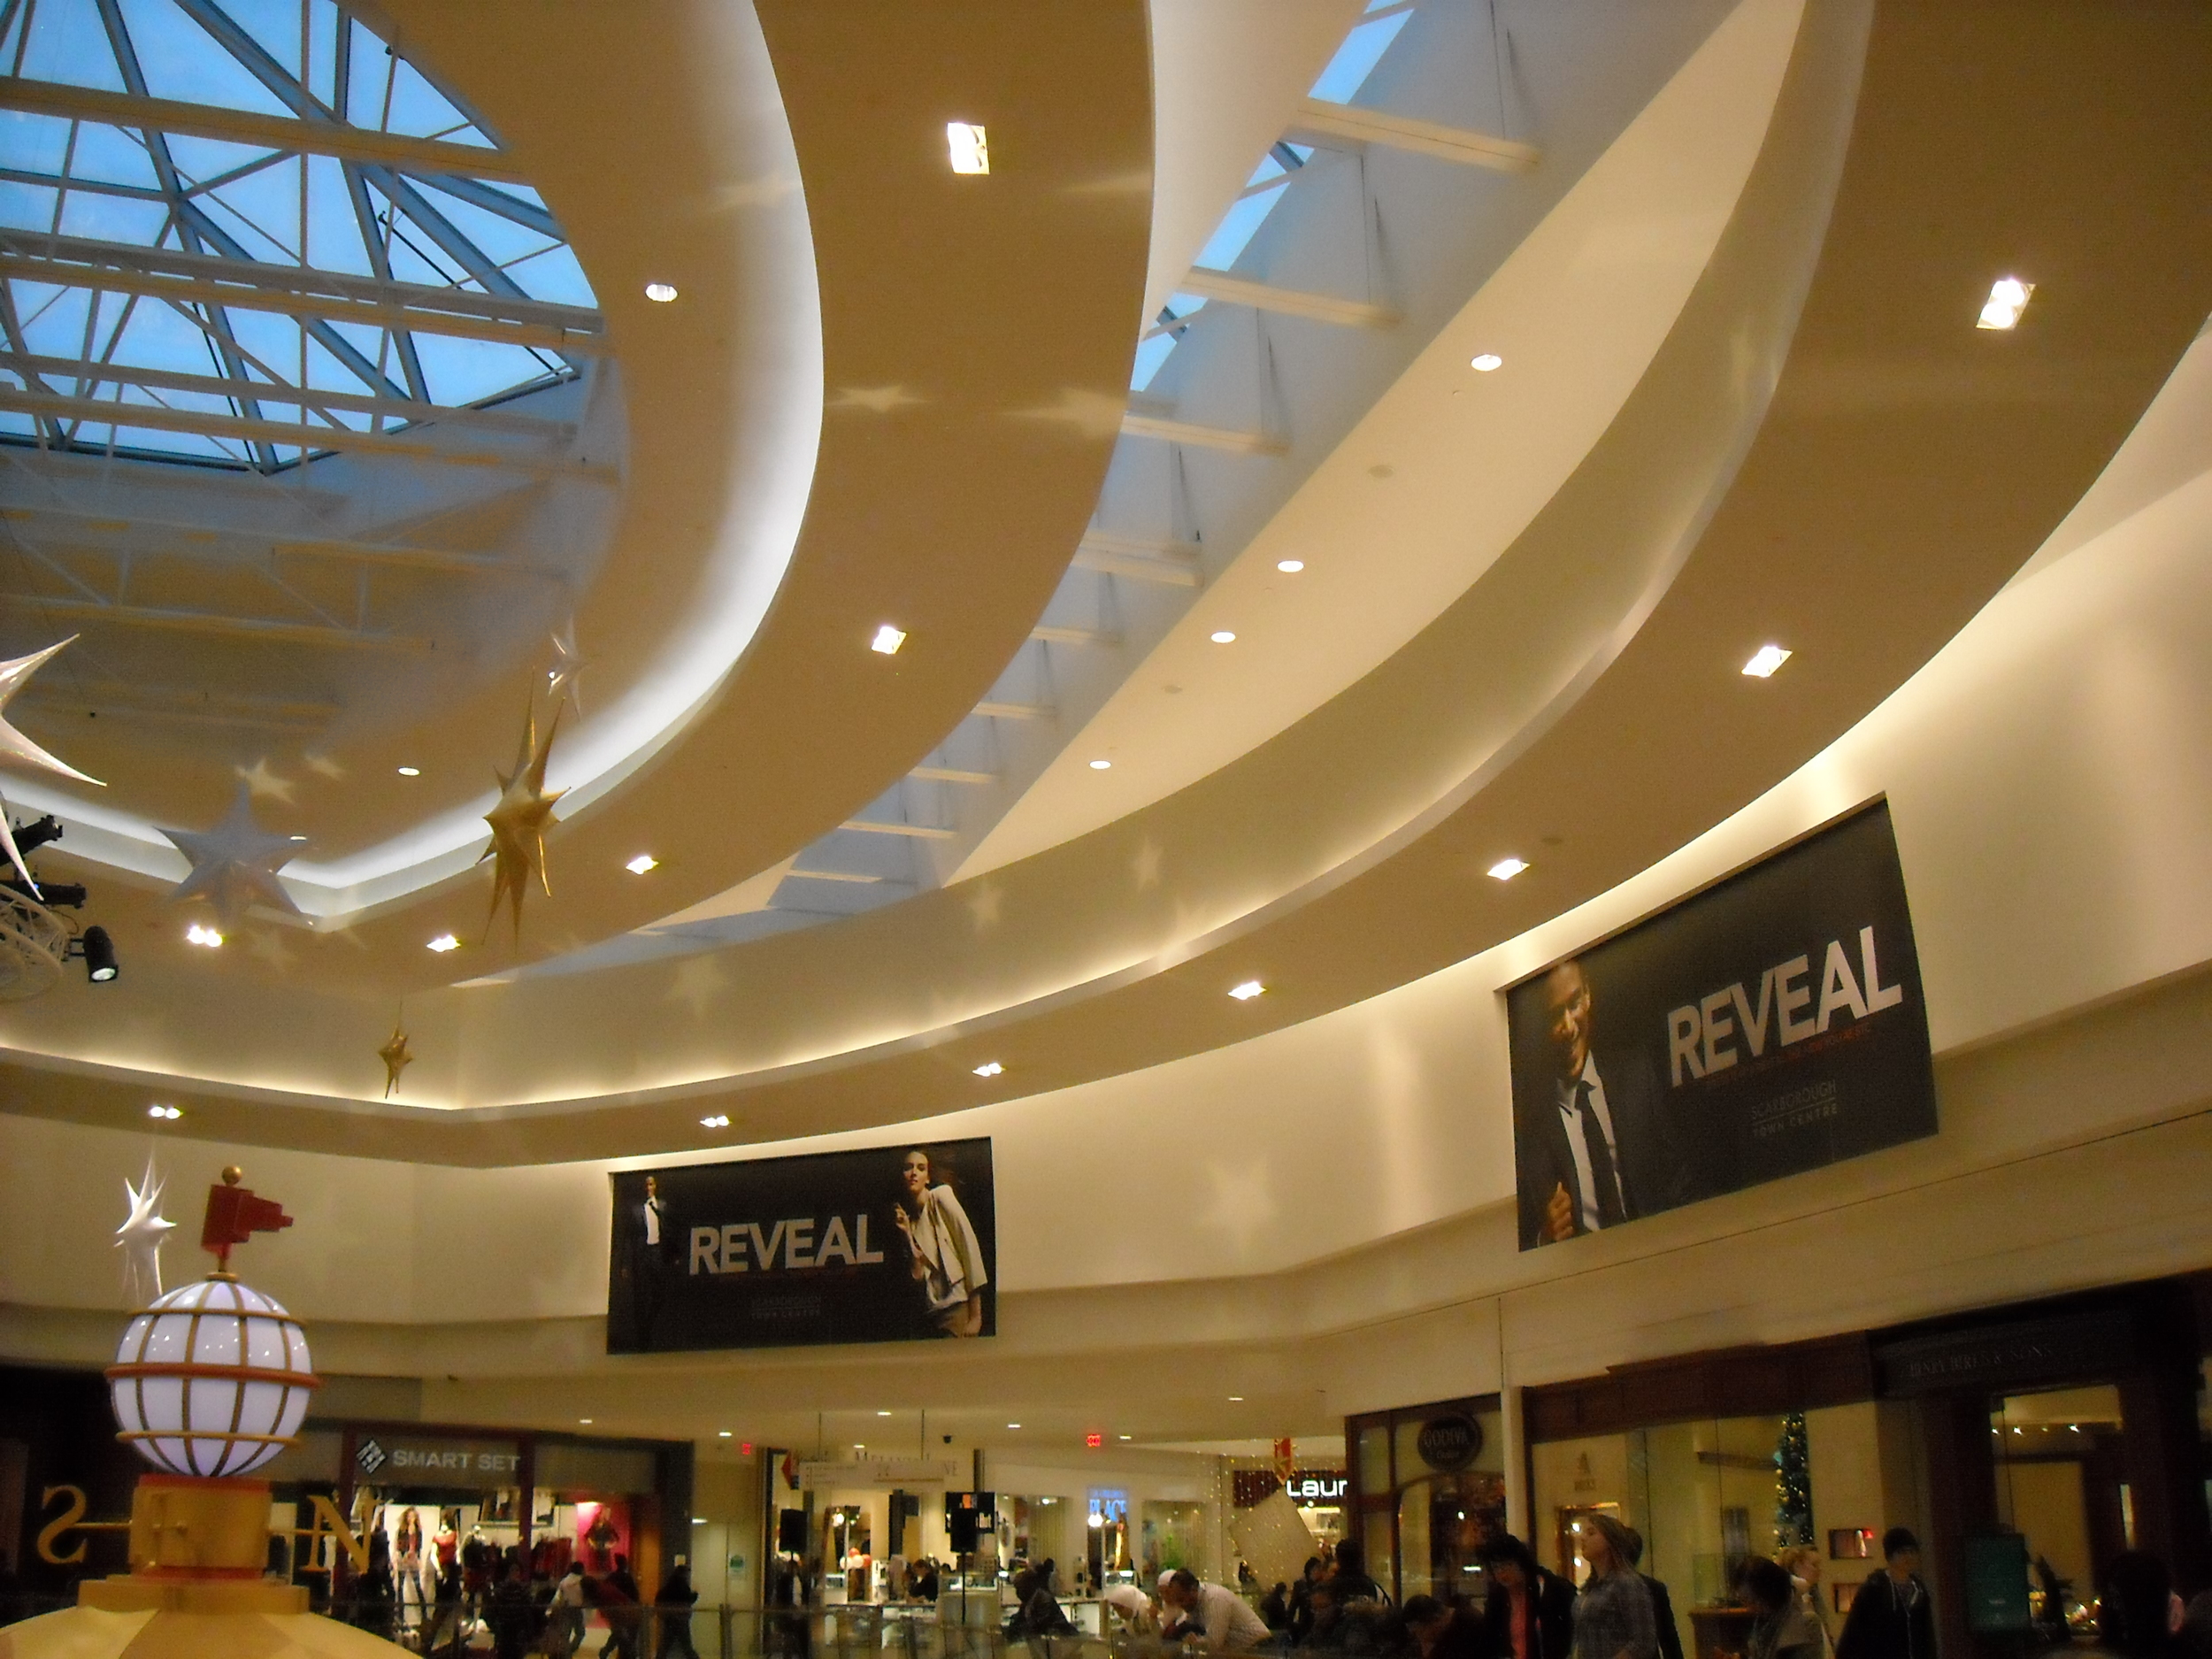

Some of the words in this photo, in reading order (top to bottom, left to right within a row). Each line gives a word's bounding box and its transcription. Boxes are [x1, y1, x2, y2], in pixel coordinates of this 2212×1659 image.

[1667, 925, 1903, 1088] REVEAL
[1751, 1079, 1838, 1120] SCARBOROUGH
[1753, 1121, 1786, 1138] TOWN
[1790, 1102, 1838, 1128] CENTRE
[689, 1214, 884, 1276] REVEAL
[393, 1450, 472, 1469] SMART
[478, 1454, 520, 1471] SET
